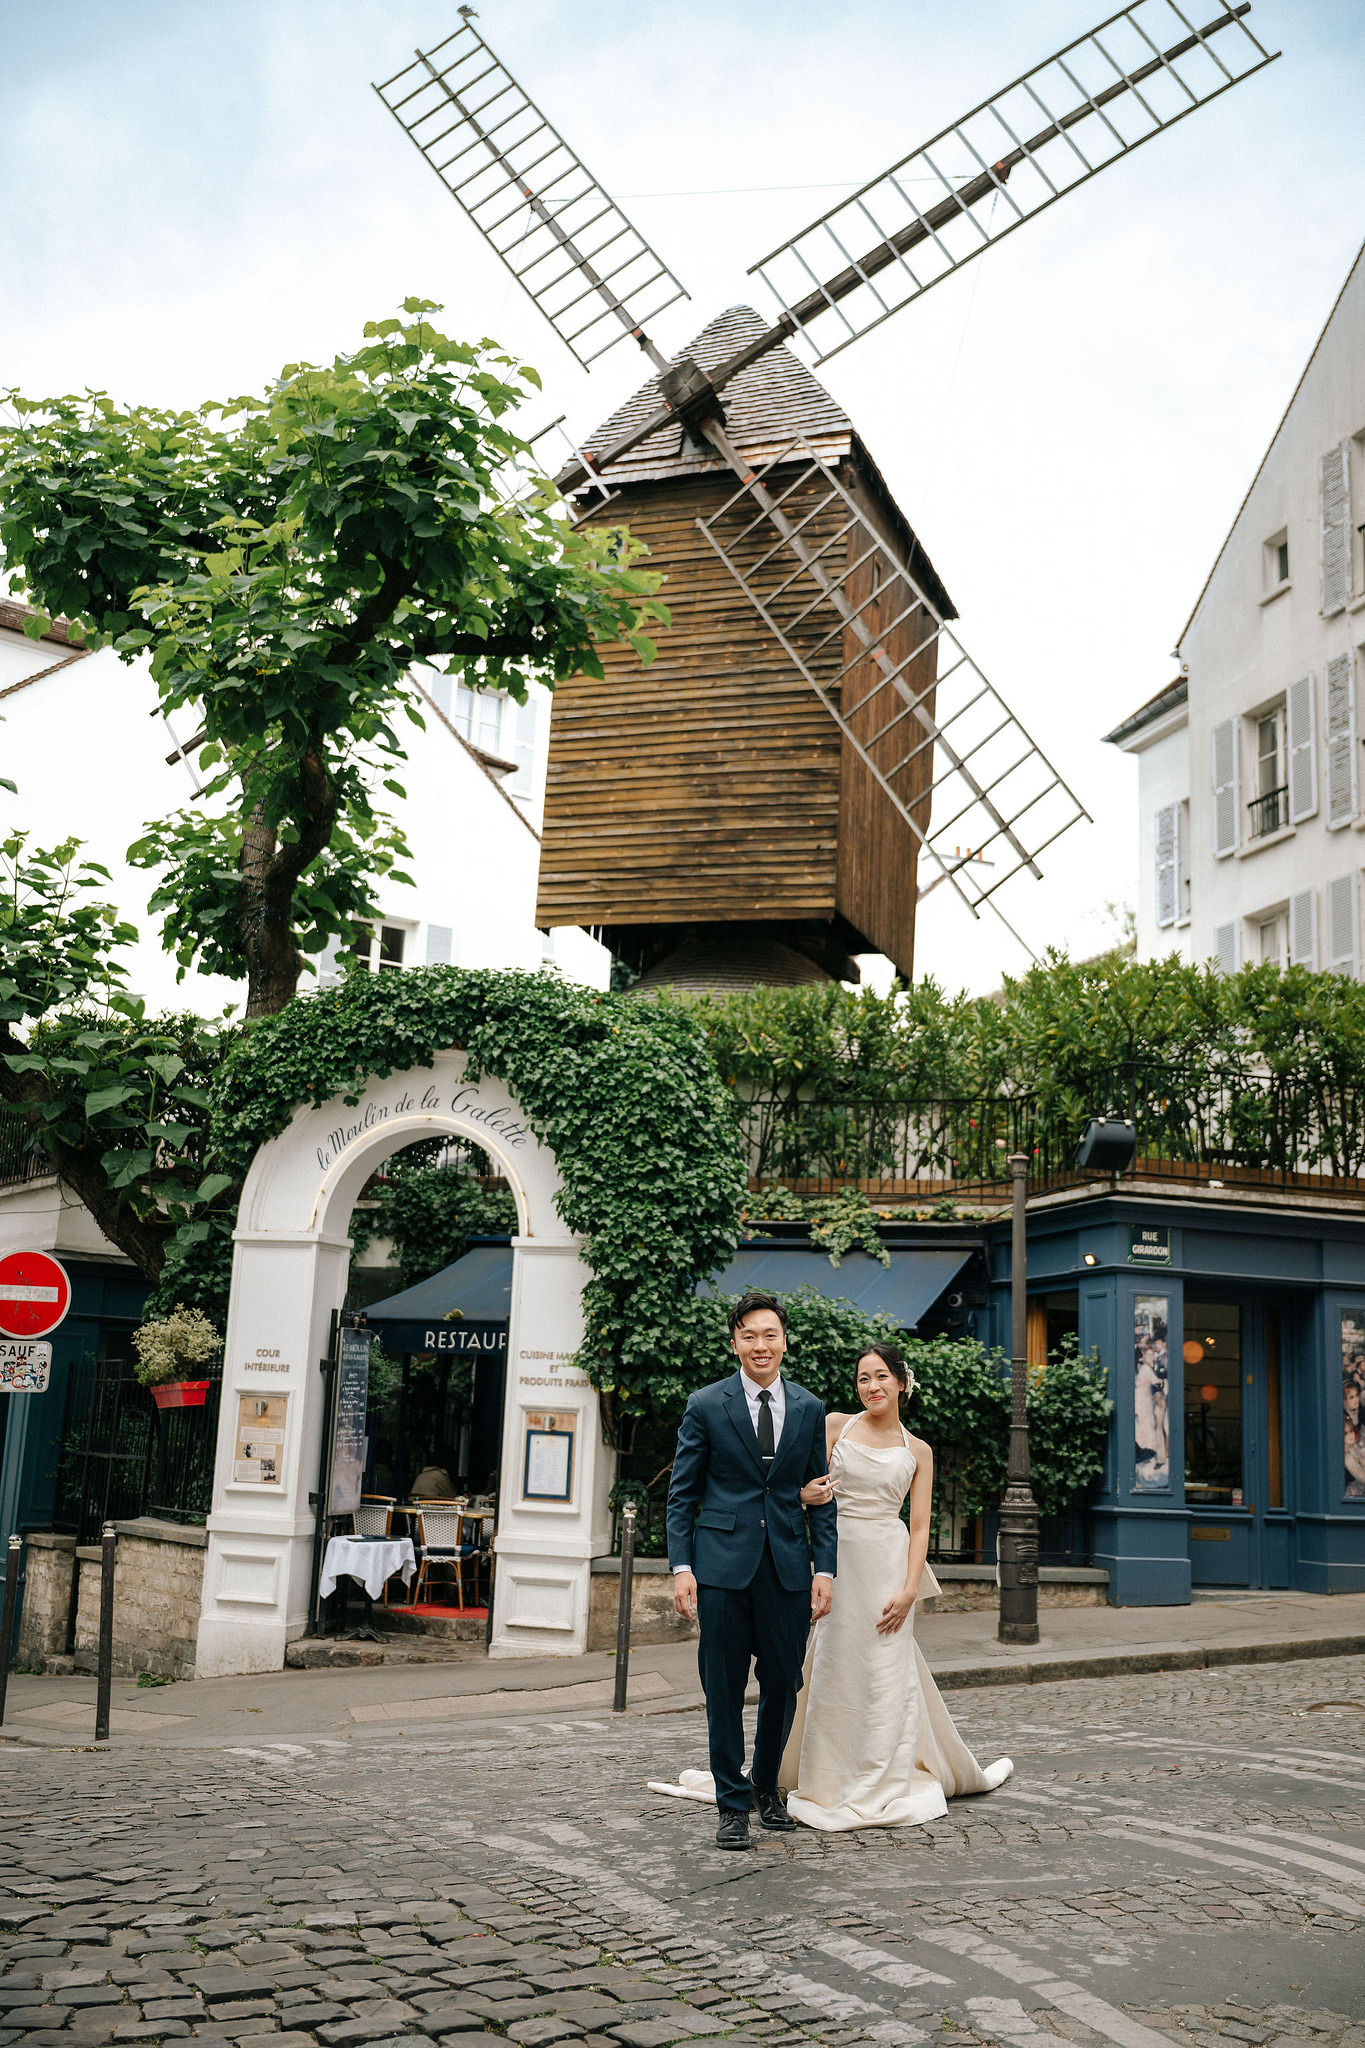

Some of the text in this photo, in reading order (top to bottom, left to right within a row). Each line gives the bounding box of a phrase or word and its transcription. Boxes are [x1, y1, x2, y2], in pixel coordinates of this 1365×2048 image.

[327, 1102, 391, 1155] Moulin
[395, 1092, 415, 1114] de
[420, 1085, 441, 1110] la
[451, 1088, 527, 1149] Galette
[1142, 1231, 1159, 1242] RUE
[1132, 1244, 1169, 1257] GIRARDON
[0, 1345, 36, 1357] SAUF
[256, 1348, 281, 1358] COUR
[519, 1350, 554, 1360] CUISINE
[244, 1361, 290, 1372] INTÉRIEURE
[549, 1364, 559, 1373] ET
[519, 1376, 589, 1388] PRODUITS FRAIS
